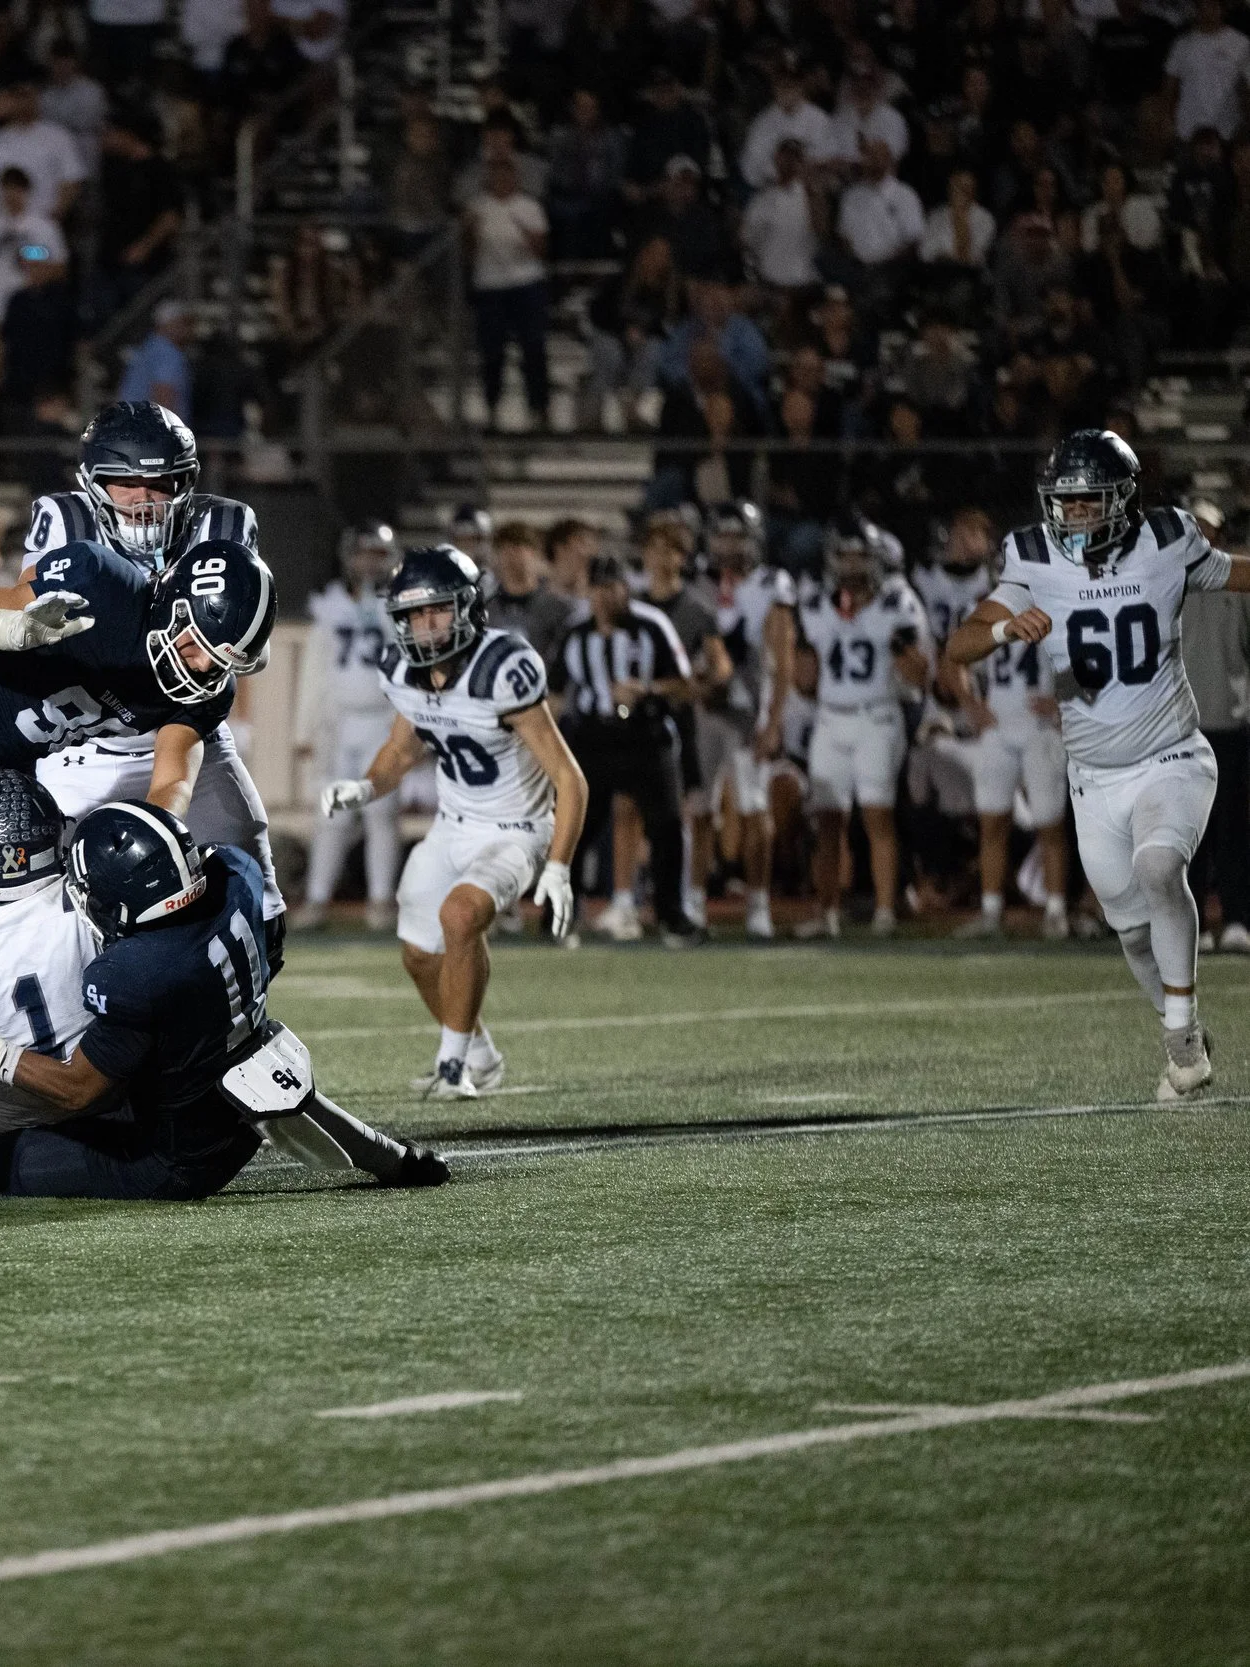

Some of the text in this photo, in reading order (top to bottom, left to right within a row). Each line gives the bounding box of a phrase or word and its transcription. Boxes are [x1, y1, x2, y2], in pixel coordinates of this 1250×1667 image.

[191, 557, 227, 596] 90
[1078, 584, 1142, 601] CHAMPION
[1066, 602, 1161, 690] 60
[505, 658, 540, 700] 20
[99, 689, 136, 723] RANGERS
[414, 712, 459, 728] CHAMPION
[71, 838, 89, 878] 11
[86, 983, 108, 1015] SV
[207, 908, 270, 1053] 11
[12, 972, 68, 1060] 1
